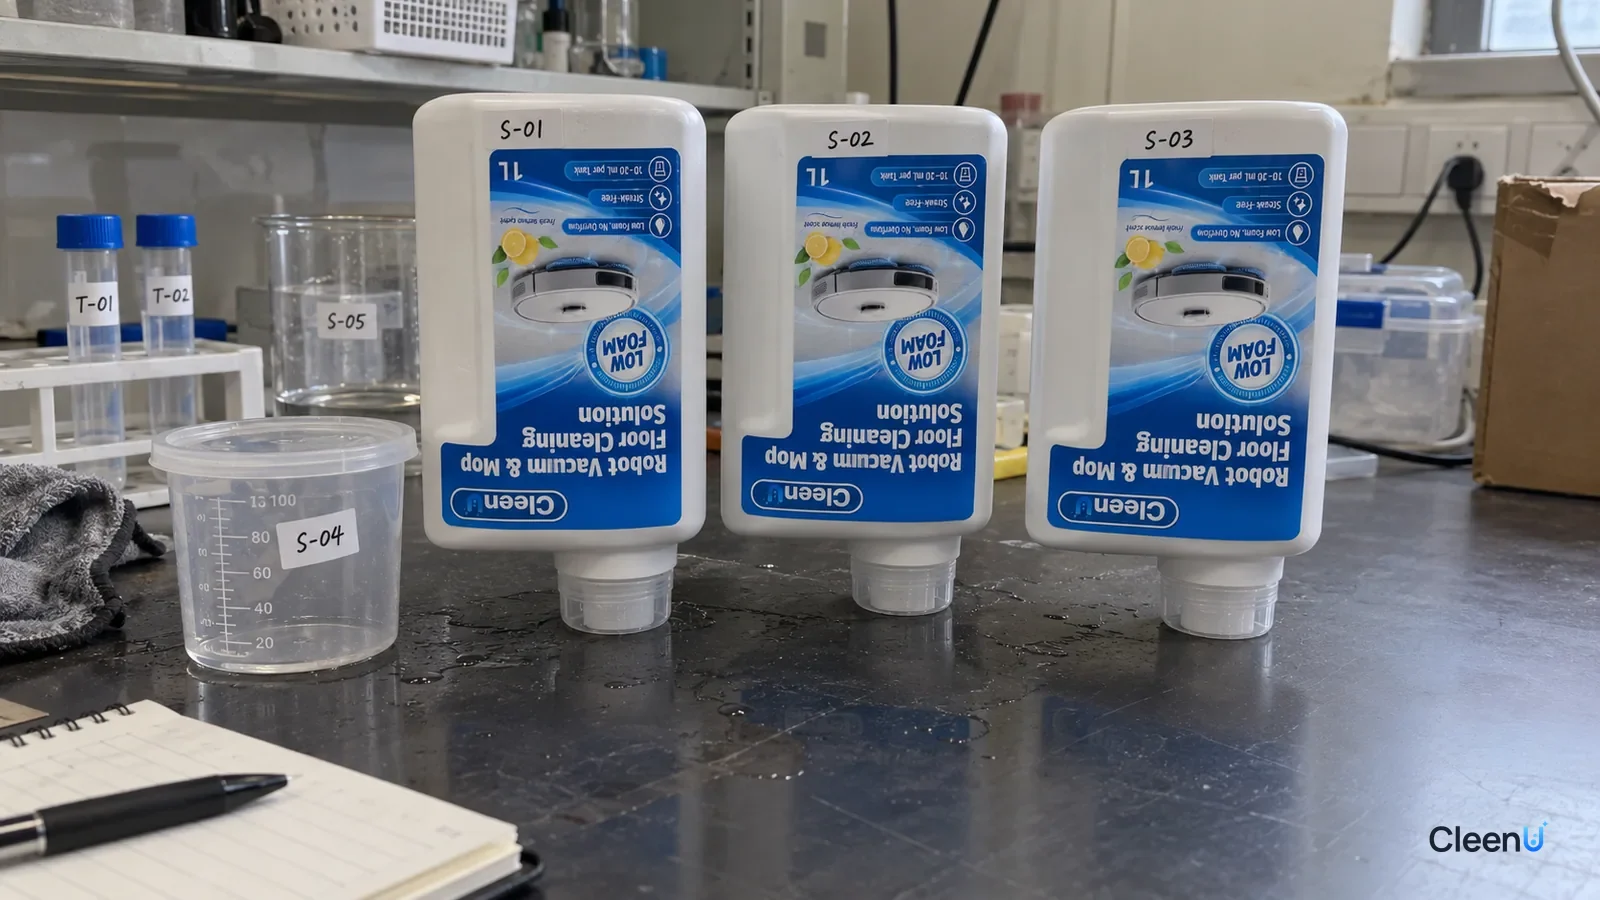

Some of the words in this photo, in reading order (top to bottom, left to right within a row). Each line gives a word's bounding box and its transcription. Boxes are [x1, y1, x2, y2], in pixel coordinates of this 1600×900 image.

[501, 119, 542, 139] S-01
[828, 130, 874, 149] S-02
[1145, 130, 1193, 150] S-03
[899, 170, 911, 179] per
[1209, 174, 1227, 183] Tank
[1229, 171, 1242, 180] per
[598, 222, 608, 231] No
[901, 226, 911, 234] No
[1230, 229, 1241, 238] No
[1266, 229, 1281, 237] Low
[75, 295, 112, 313] T-01
[152, 288, 190, 304] T-02
[328, 312, 366, 330] S-05
[603, 330, 647, 356] FOAM
[901, 330, 945, 354] FOAM
[1228, 337, 1276, 362] FOAM
[610, 350, 643, 373] LOW
[908, 350, 941, 371] LOW
[1234, 358, 1271, 380] LOW
[579, 404, 666, 427] Solution
[877, 403, 962, 424] Solution
[1196, 413, 1291, 436] Solution
[522, 427, 614, 453] Cleaning
[619, 429, 666, 451] Floor
[820, 422, 911, 449] Cleaning
[915, 428, 962, 448] Floor
[1136, 431, 1232, 461] Cleaning
[1237, 440, 1290, 462] Floor
[461, 453, 500, 476] Mop
[505, 458, 521, 477] &
[527, 458, 602, 477] Vacuum
[608, 454, 667, 476] Robot
[765, 446, 807, 470] Mop
[812, 452, 828, 471] &
[833, 453, 904, 473] Vacuum
[909, 452, 962, 472] Robot
[1073, 456, 1115, 481] Mop
[1121, 462, 1137, 482] &
[1143, 464, 1219, 486] Vacuum
[1225, 466, 1288, 488] Robot
[270, 494, 296, 507] 100
[251, 531, 270, 543] 80
[296, 525, 344, 553] S-04
[253, 567, 271, 580] 60
[254, 602, 272, 614] 40
[256, 637, 273, 649] 20
